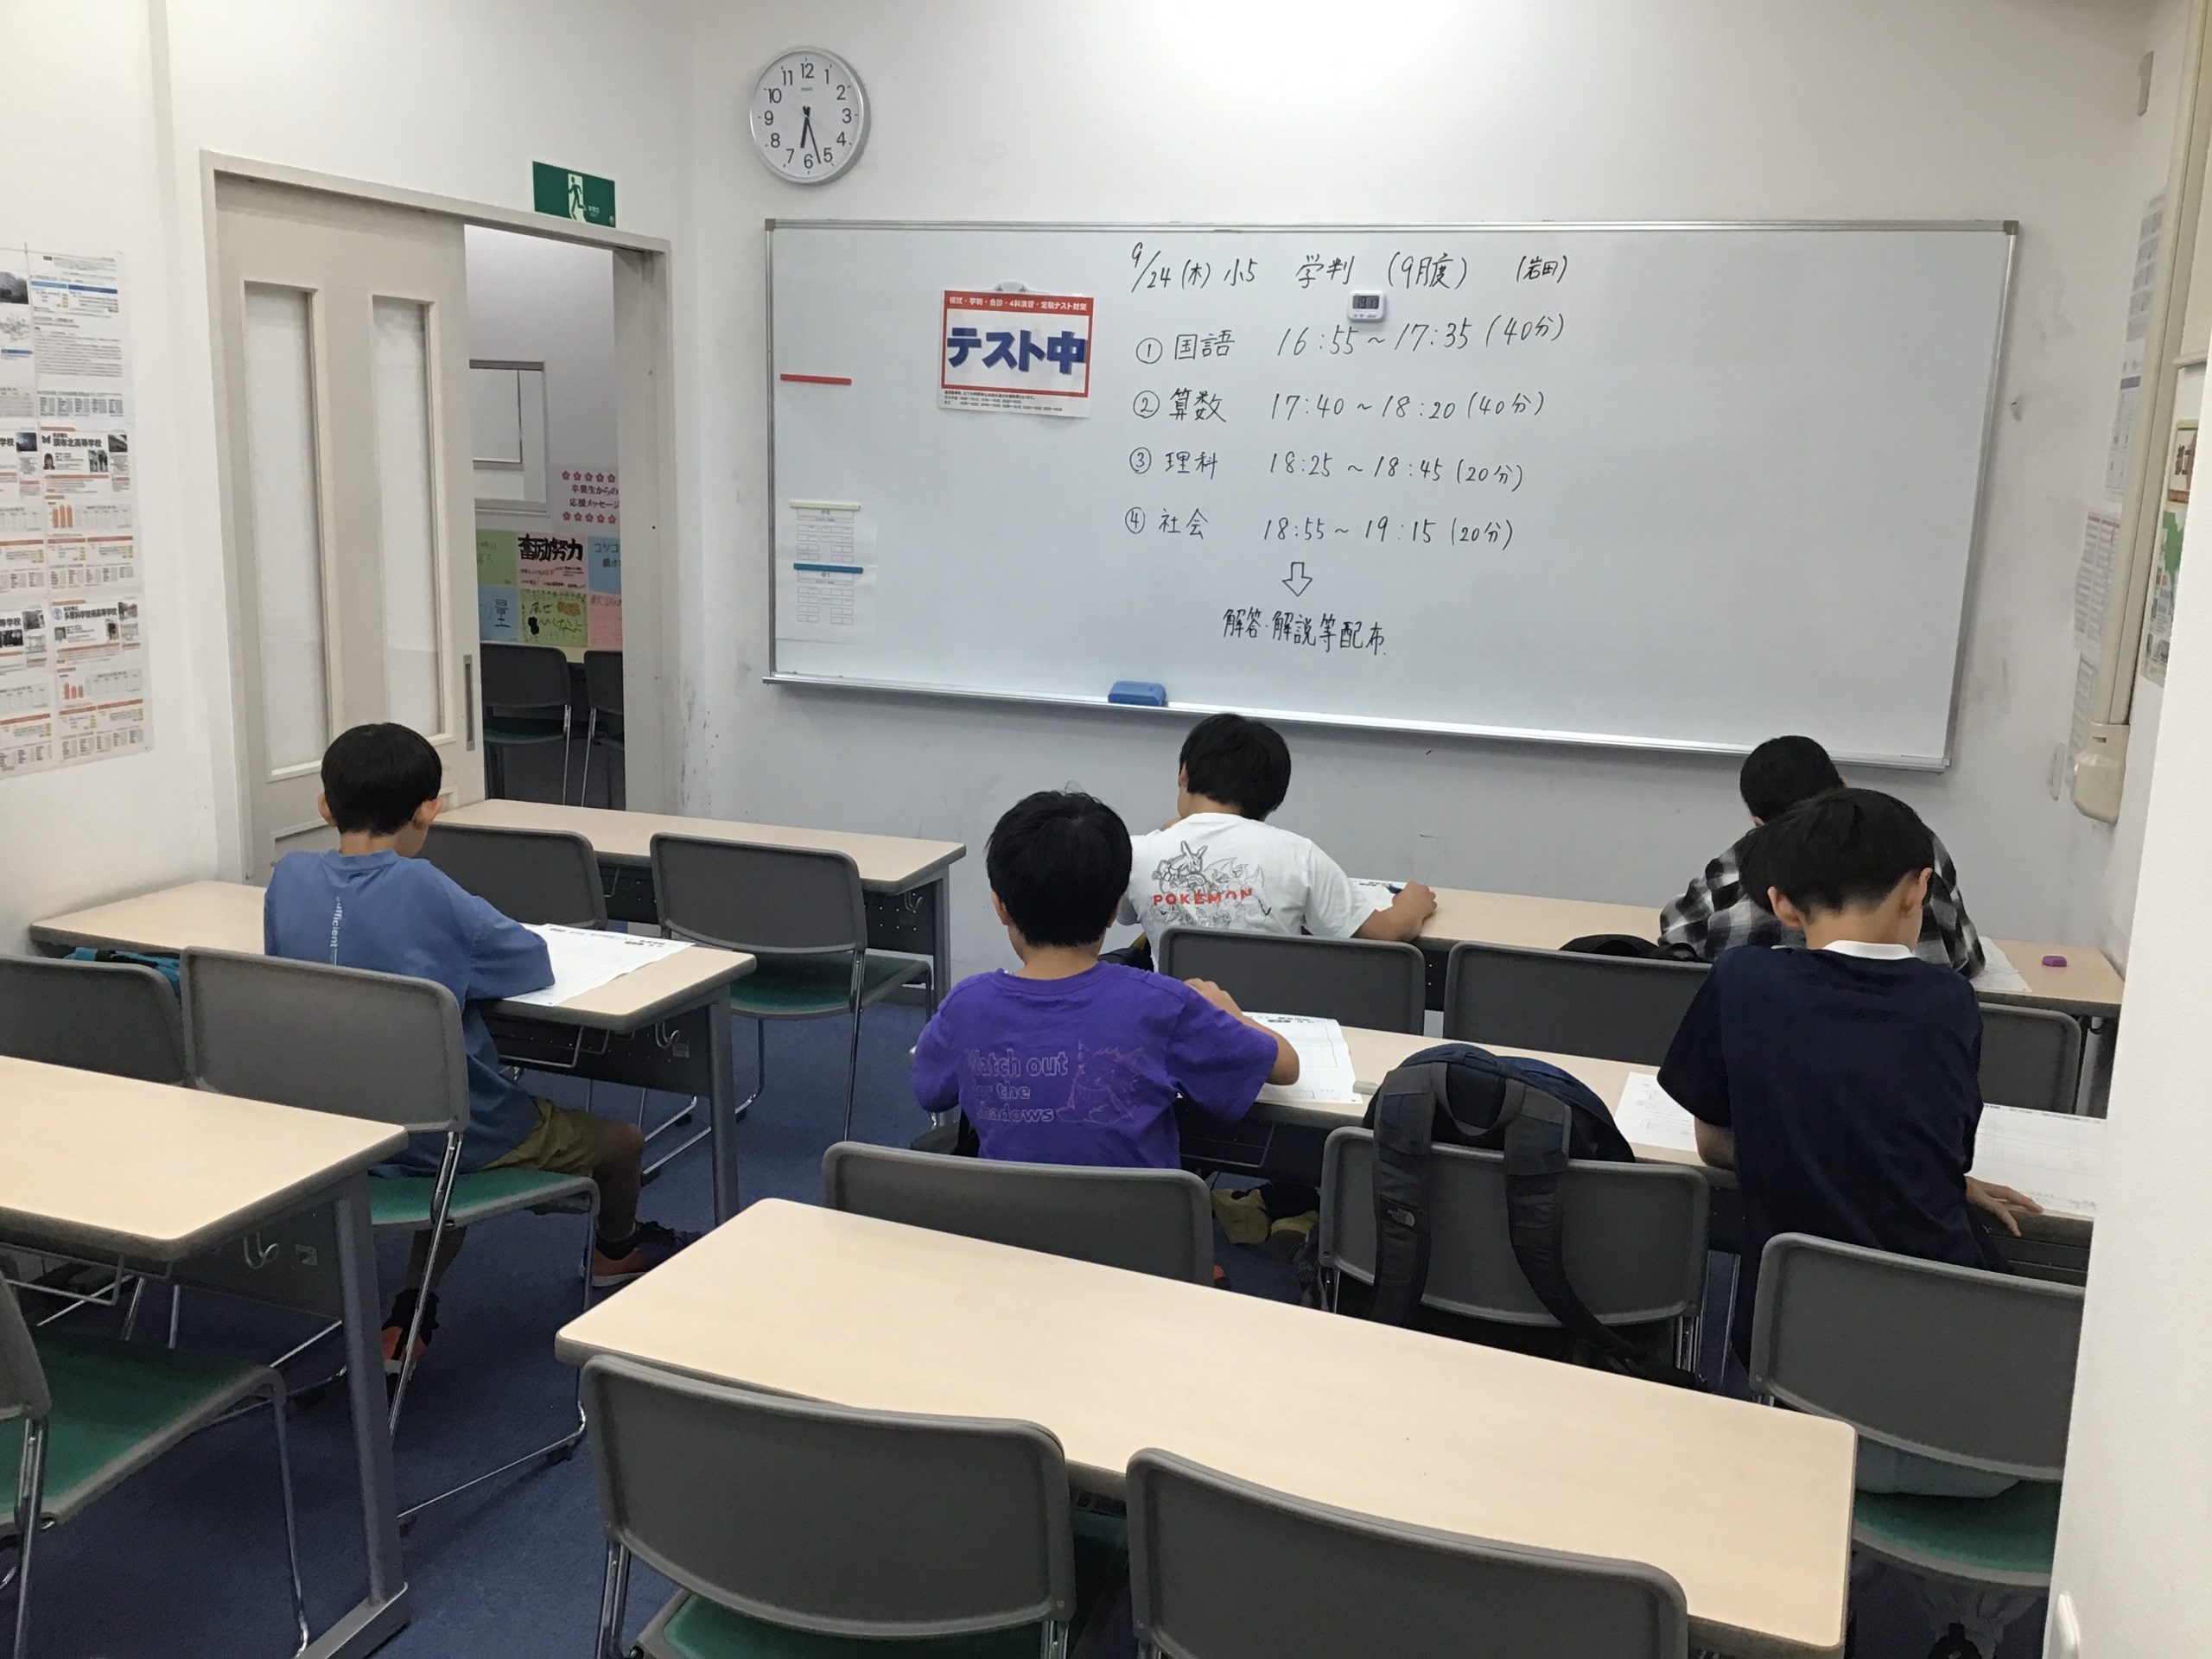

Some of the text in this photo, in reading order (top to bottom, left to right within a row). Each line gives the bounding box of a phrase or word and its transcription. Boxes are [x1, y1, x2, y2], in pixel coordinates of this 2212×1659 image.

[782, 70, 793, 86] 11
[800, 63, 815, 79] 12
[824, 69, 830, 85] 1
[767, 88, 782, 104] 10
[836, 85, 846, 100] 2
[764, 110, 774, 125] 9
[842, 108, 852, 124] 3
[770, 133, 780, 148] 8
[836, 131, 847, 147] 4
[785, 149, 795, 164] 7
[804, 154, 813, 168] 6
[823, 147, 833, 162] 5
[1224, 257, 1259, 287] 小5
[1294, 253, 1355, 289] 学判
[1388, 251, 1467, 290] (9月度)
[1516, 255, 1568, 283] (岩田)
[1174, 329, 1236, 360] 国語
[1485, 313, 1564, 348] (40分)
[946, 327, 1087, 375] テスト中
[1168, 387, 1227, 423] 算数
[1467, 391, 1544, 419] (40分)
[1165, 450, 1218, 480] 理科
[1456, 458, 1522, 493] (20分)
[1158, 507, 1210, 540] 社会
[1451, 517, 1514, 551] (20分)
[1026, 1052, 1069, 1077] out
[995, 1080, 1031, 1100] the
